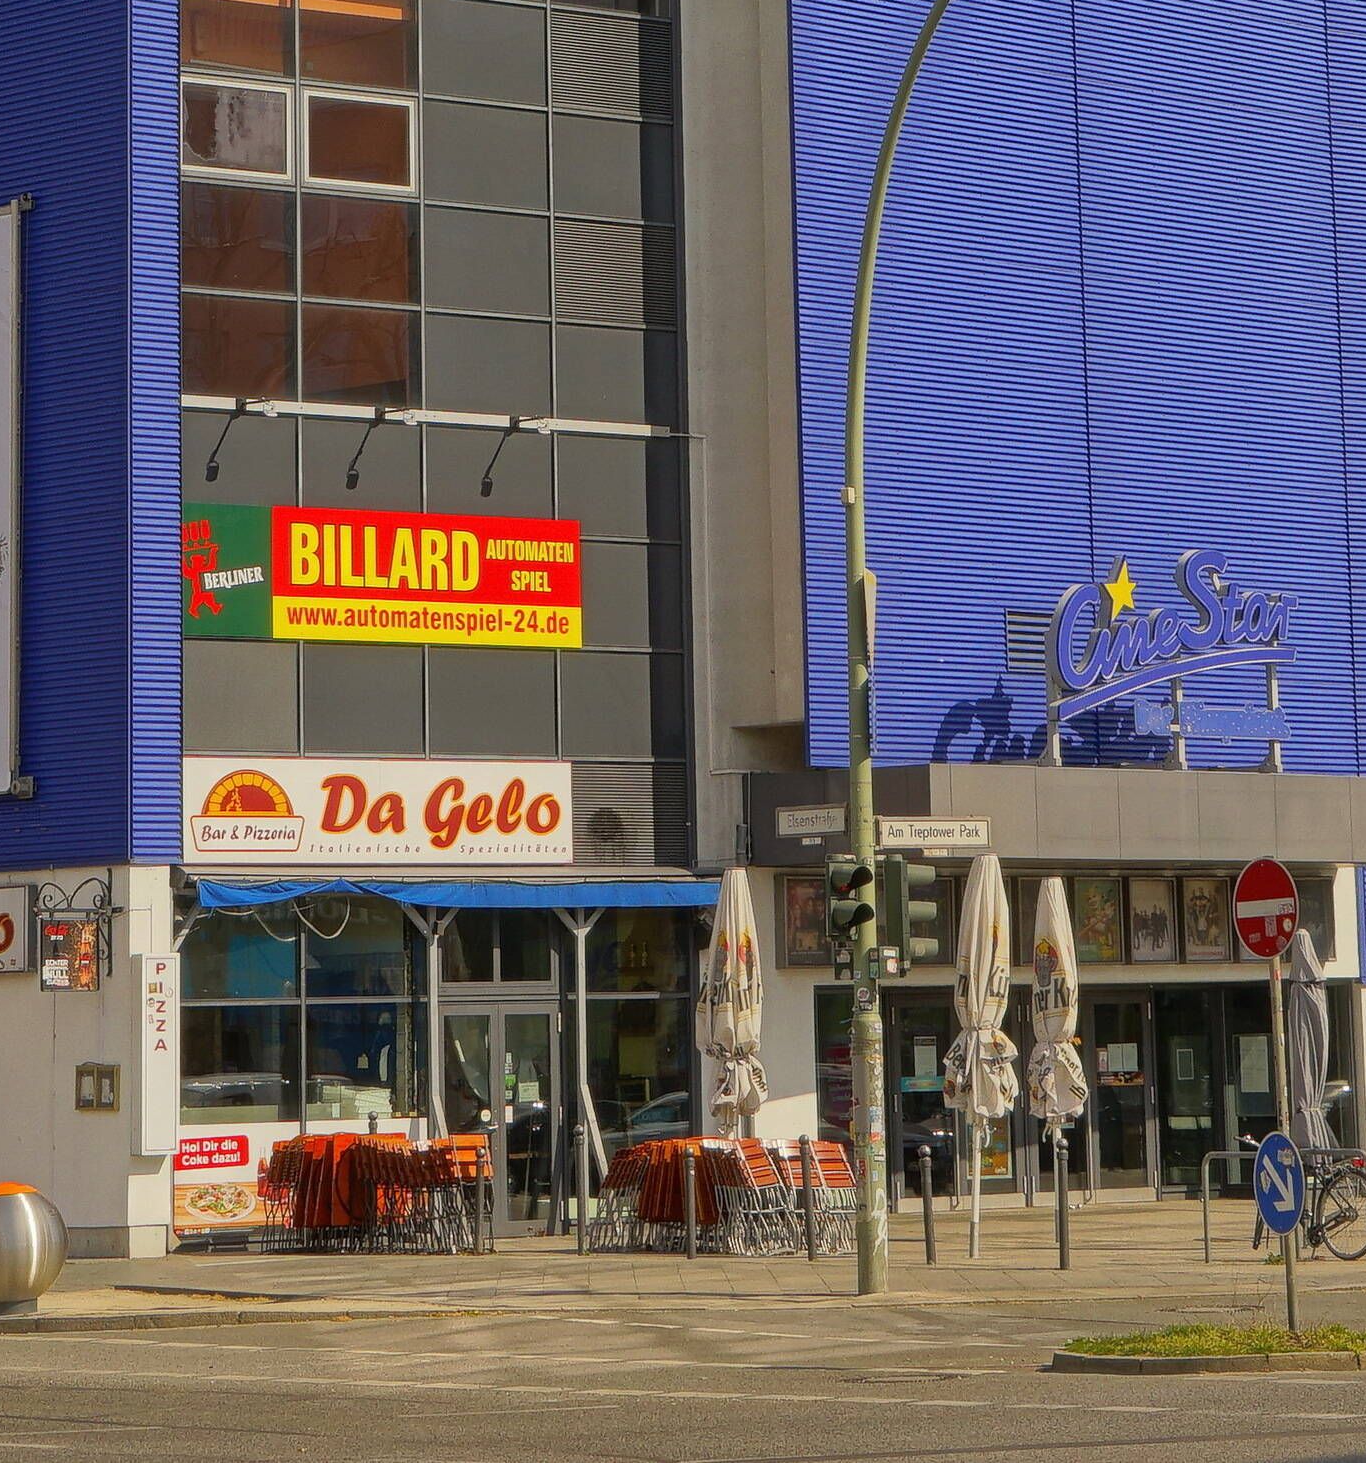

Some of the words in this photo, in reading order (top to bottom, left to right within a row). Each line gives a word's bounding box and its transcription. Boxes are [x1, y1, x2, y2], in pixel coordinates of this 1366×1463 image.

[289, 522, 480, 593] BILLARD
[485, 537, 575, 564] AUTOMATEN
[203, 565, 264, 591] BERLINER
[511, 570, 552, 593] SPIEL
[287, 605, 570, 637] www.automatenspiel-24.de
[1047, 548, 1299, 690] CineStar
[320, 773, 407, 834] Da
[423, 775, 562, 848] Gelo
[201, 824, 228, 842] Bar
[229, 824, 240, 841] &
[243, 823, 296, 844] Pizzeria
[887, 824, 904, 838] Am
[909, 824, 955, 841] Treptower
[959, 824, 981, 838] Park
[459, 843, 569, 855] Spezialitäten
[154, 962, 168, 1051] PIZZA
[181, 1142, 200, 1153] Hol
[202, 1140, 219, 1152] Dir
[221, 1139, 238, 1150] die
[181, 1154, 210, 1166] Coke
[212, 1152, 241, 1163] dazu!
